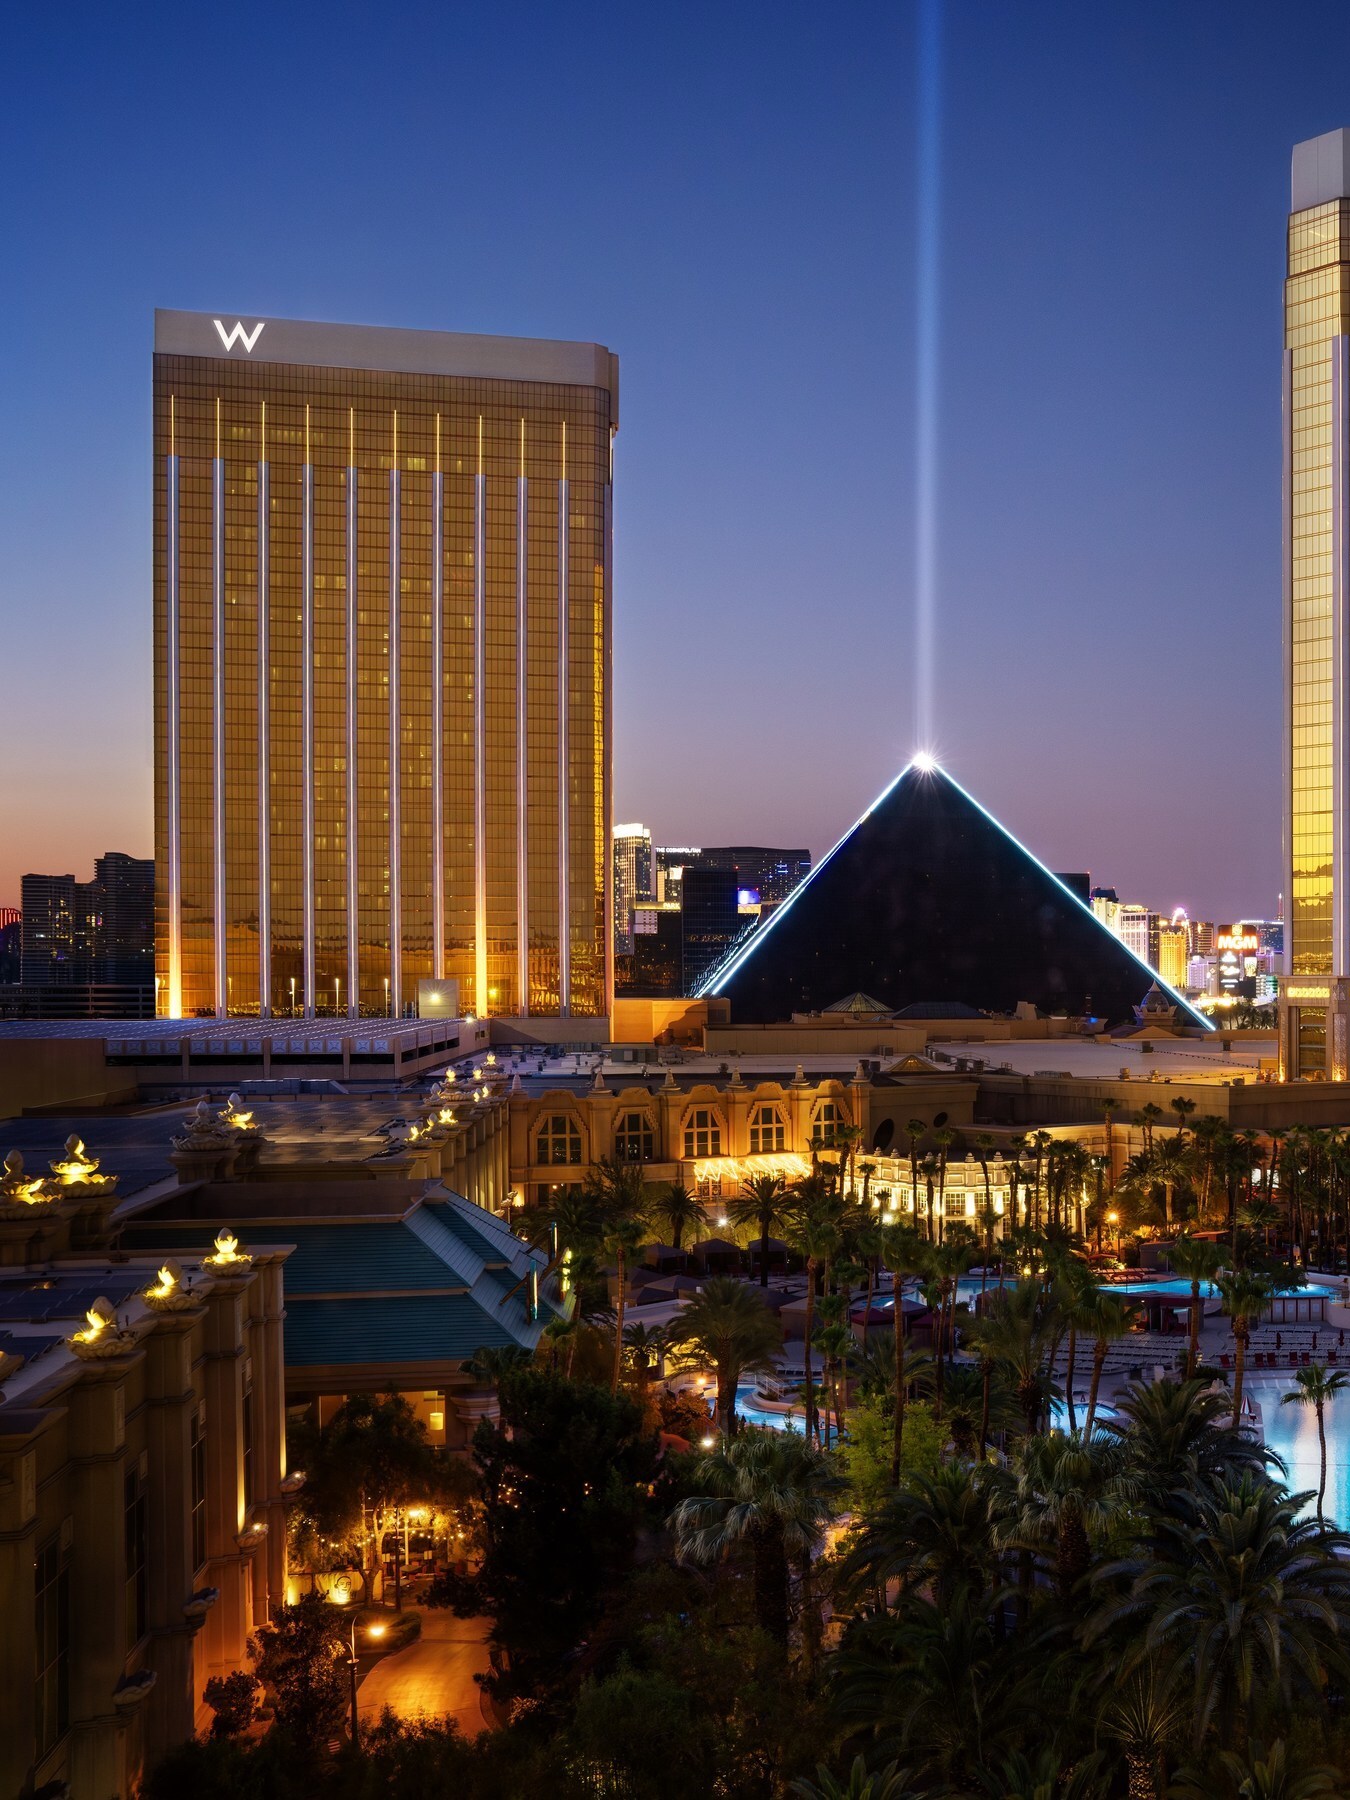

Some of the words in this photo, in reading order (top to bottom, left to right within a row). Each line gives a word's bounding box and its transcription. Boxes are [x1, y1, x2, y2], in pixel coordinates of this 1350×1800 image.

[213, 319, 266, 354] W
[663, 902, 681, 910] PARK
[1217, 935, 1258, 950] MGM
